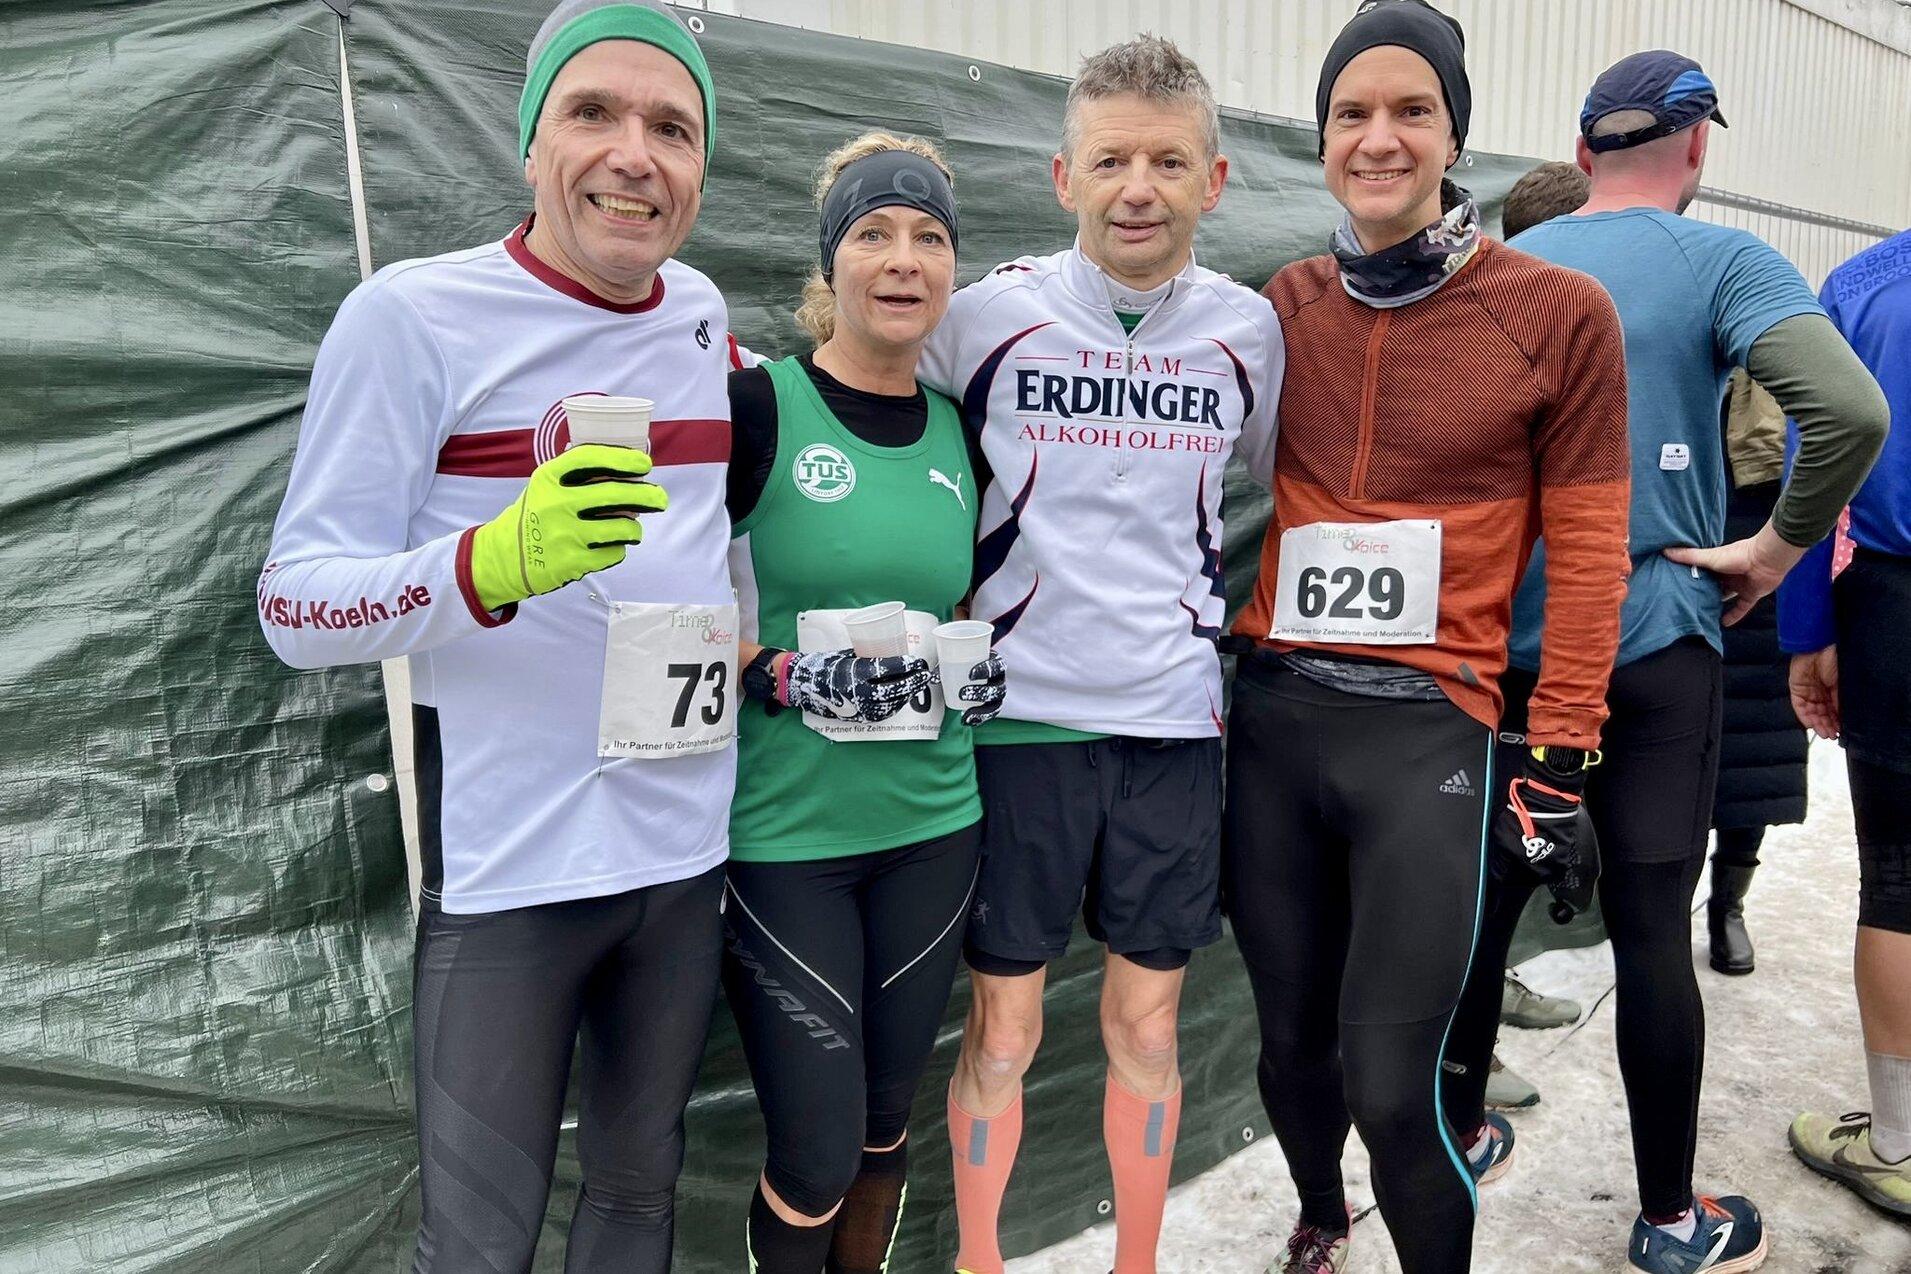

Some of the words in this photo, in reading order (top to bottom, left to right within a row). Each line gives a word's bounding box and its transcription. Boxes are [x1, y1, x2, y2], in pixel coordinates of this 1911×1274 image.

[1077, 350, 1182, 376] TEAM
[1015, 369, 1225, 430] ERDINGER
[1018, 424, 1224, 454] ALKOHOLFREI
[802, 462, 848, 480] TUS
[529, 511, 546, 569] GORE
[1315, 526, 1350, 540] Time
[1297, 566, 1405, 621] 629
[668, 610, 708, 628] Time
[1291, 627, 1312, 635] Partner
[1323, 628, 1360, 637] Zeitnahme
[1379, 630, 1422, 638] Moderation
[667, 661, 727, 728] 73
[825, 726, 853, 734] Partner
[854, 725, 866, 733] für
[867, 724, 906, 733] Zeitnahme
[614, 740, 627, 749] Ihr
[629, 741, 663, 751] Partner
[664, 742, 676, 750] für
[677, 739, 710, 749] Zeitnahme
[1440, 783, 1475, 797] adidas
